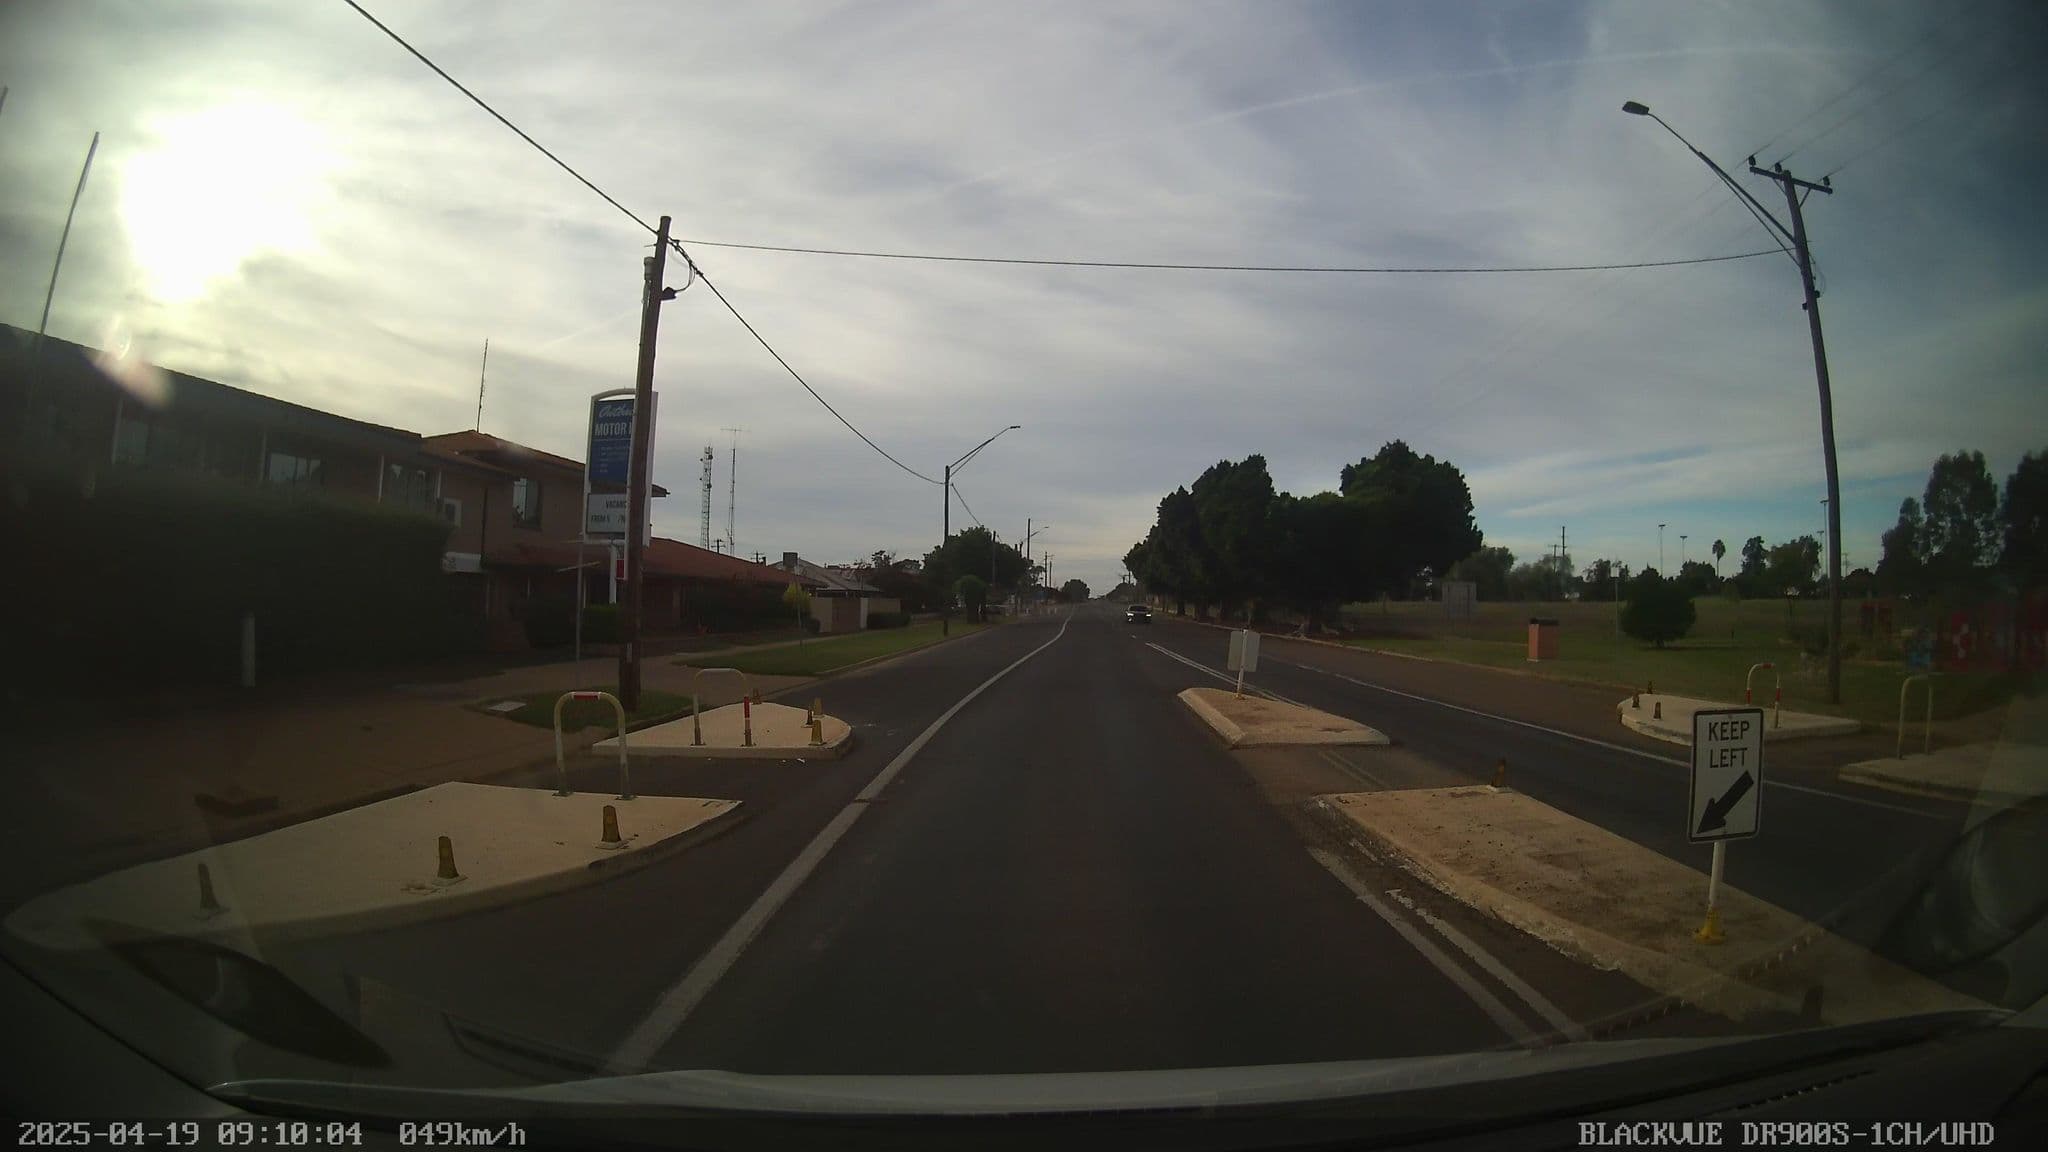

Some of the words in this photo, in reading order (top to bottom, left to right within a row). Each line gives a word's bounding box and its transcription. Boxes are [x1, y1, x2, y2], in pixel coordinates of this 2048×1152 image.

[595, 422, 627, 437] MOTOR
[1708, 721, 1750, 741] KEEP
[1710, 747, 1748, 768] LEFT
